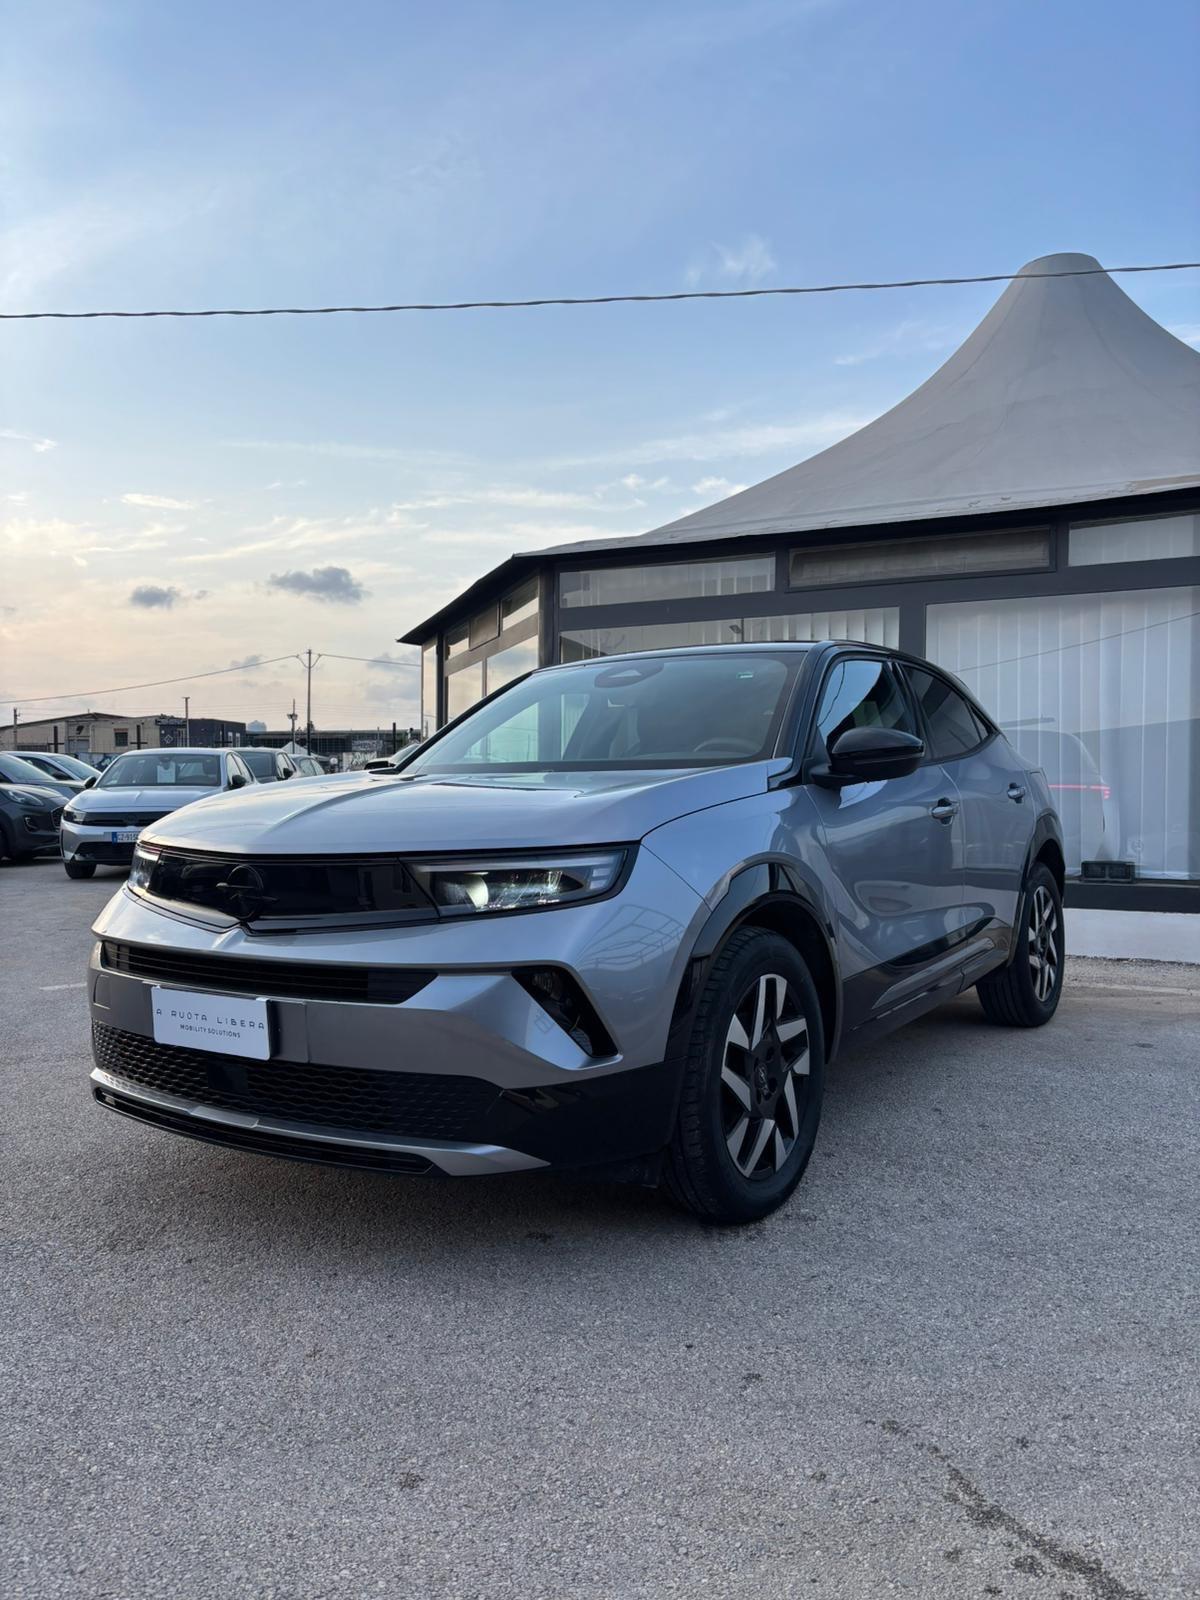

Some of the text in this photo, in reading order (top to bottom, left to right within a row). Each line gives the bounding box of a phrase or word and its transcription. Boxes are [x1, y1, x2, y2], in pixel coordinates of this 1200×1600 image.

[171, 1010, 208, 1021] RUOTA
[216, 1016, 265, 1030] LIBERA
[179, 1024, 241, 1038] MOBILITY SOLUTIONS
